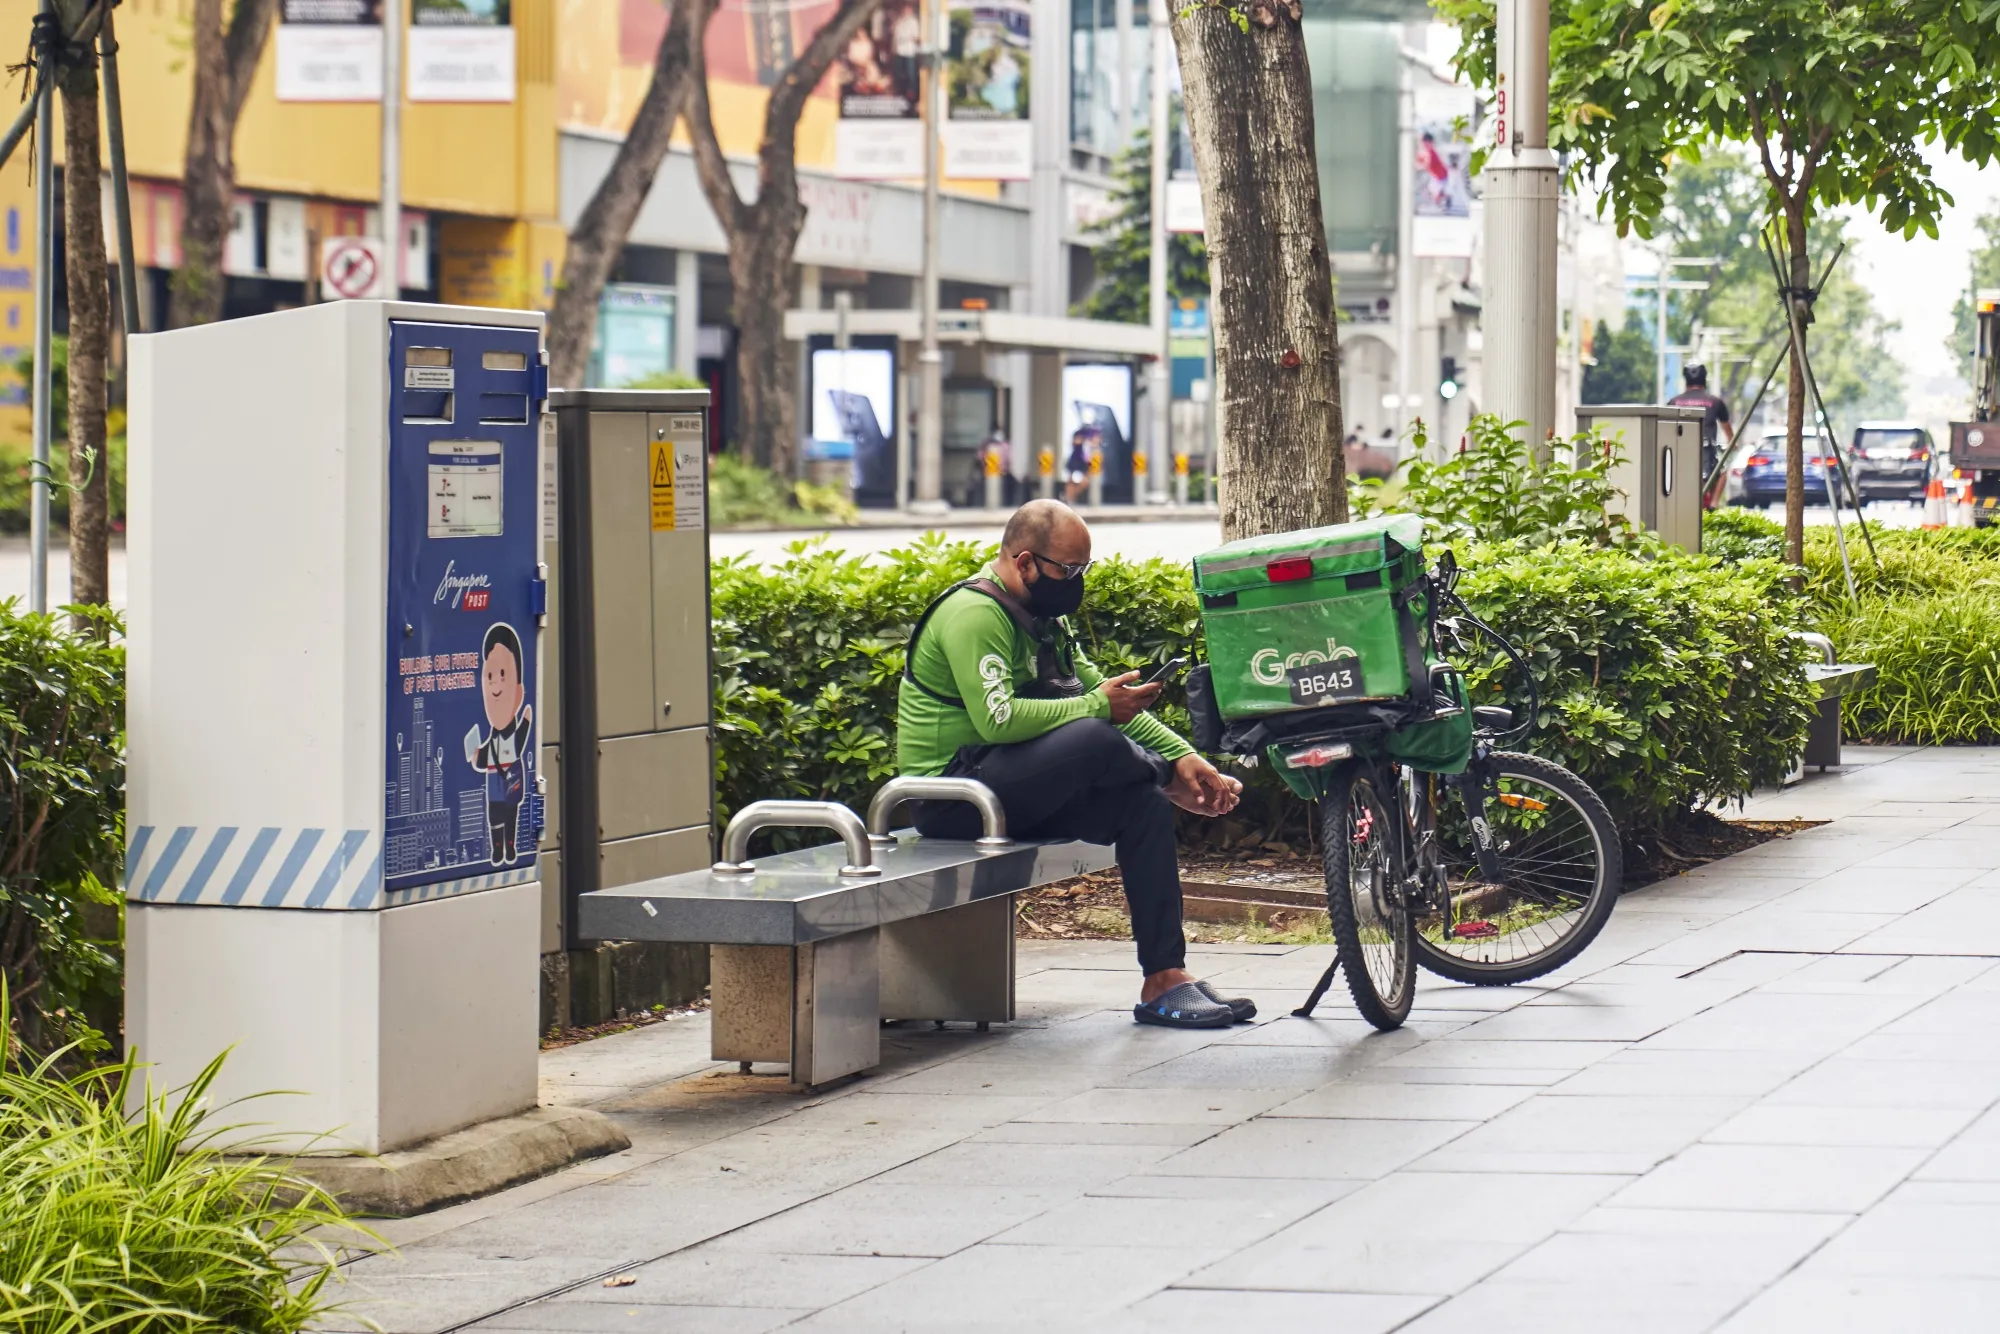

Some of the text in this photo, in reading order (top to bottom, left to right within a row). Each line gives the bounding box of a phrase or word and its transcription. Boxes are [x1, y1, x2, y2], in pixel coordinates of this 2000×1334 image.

[433, 559, 491, 609] Singapore
[468, 594, 488, 607] POST
[400, 653, 479, 675] BUILDING OUR FUTURE
[404, 672, 476, 694] OF POST TOGETHER
[1299, 669, 1353, 696] B643
